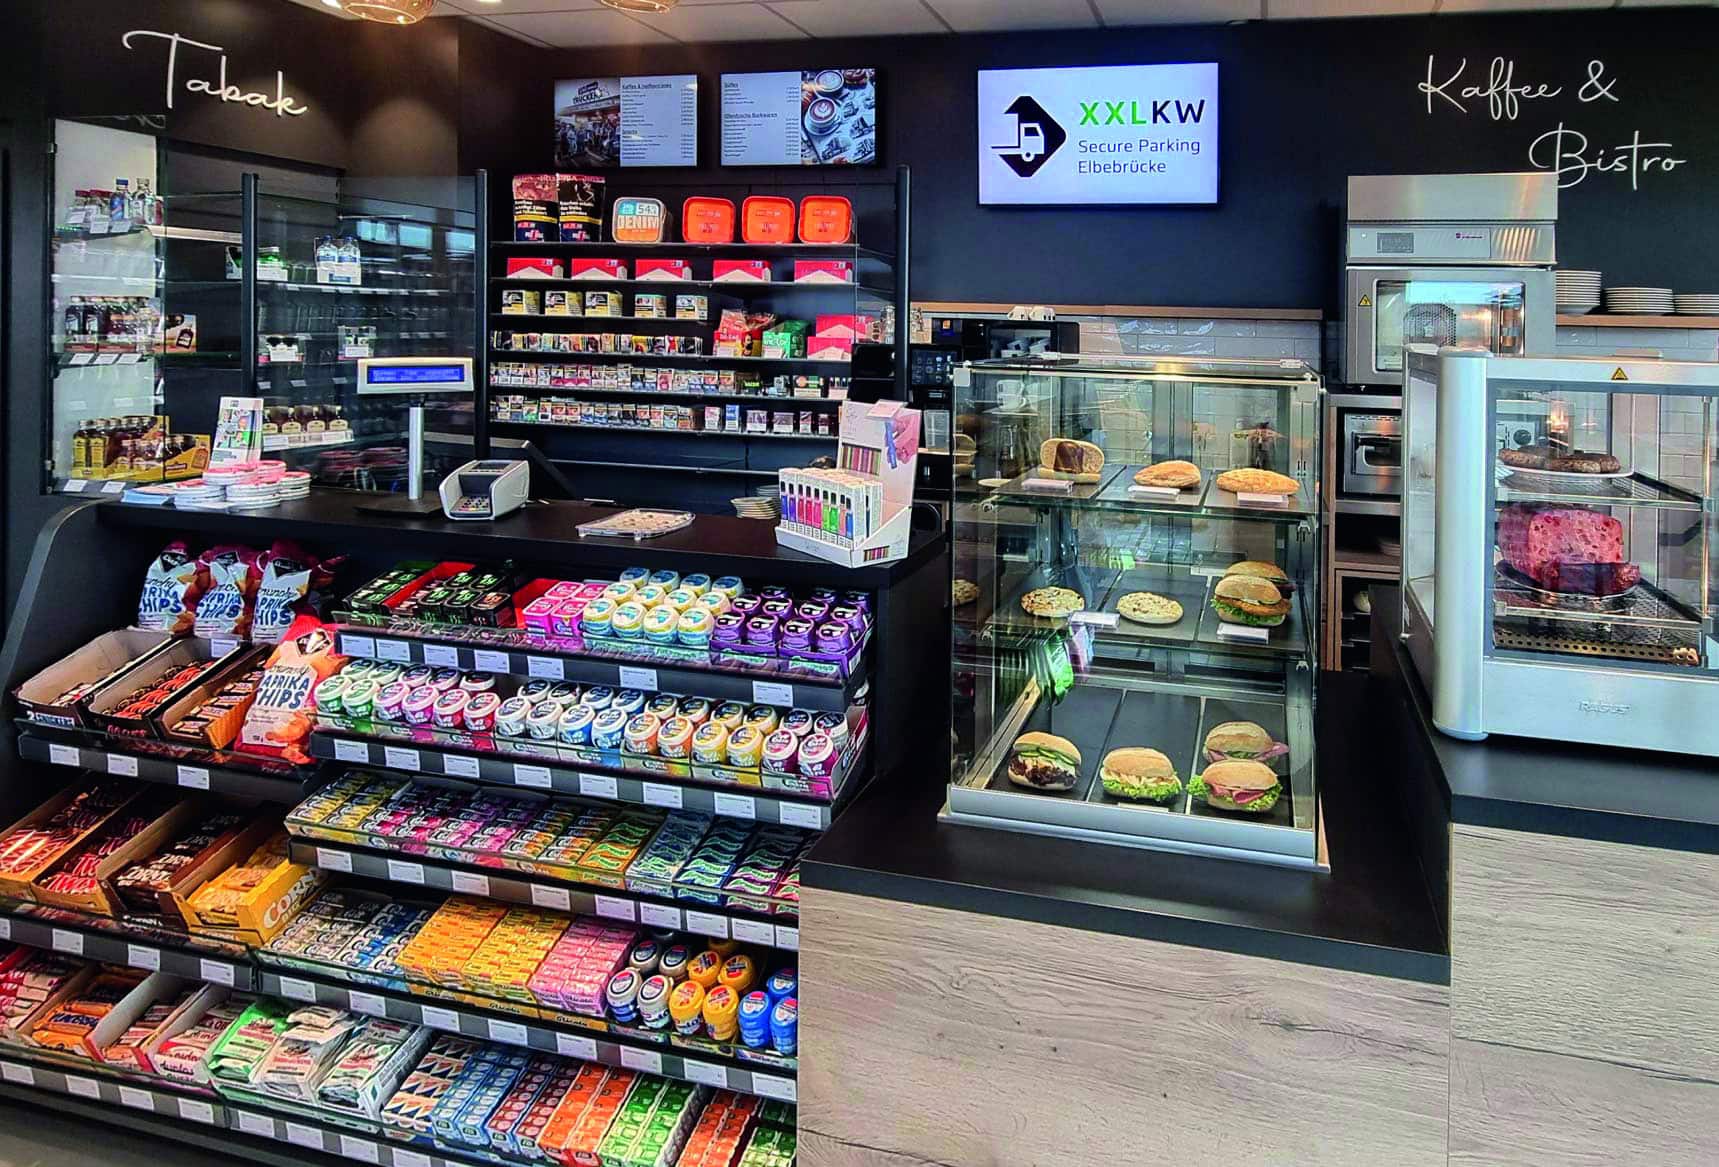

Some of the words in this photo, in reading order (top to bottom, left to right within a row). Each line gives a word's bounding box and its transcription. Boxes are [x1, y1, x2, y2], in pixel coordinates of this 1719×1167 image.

[122, 30, 307, 115] Tabak
[1418, 55, 1562, 120] Kaffee
[1577, 59, 1620, 103] &
[1079, 99, 1206, 126] XXLKW
[1078, 140, 1133, 153] Secure
[1139, 138, 1201, 155] Parking
[1528, 122, 1687, 191] Bistro
[1078, 160, 1167, 174] Elbebrücke
[256, 608, 292, 625] HIPS
